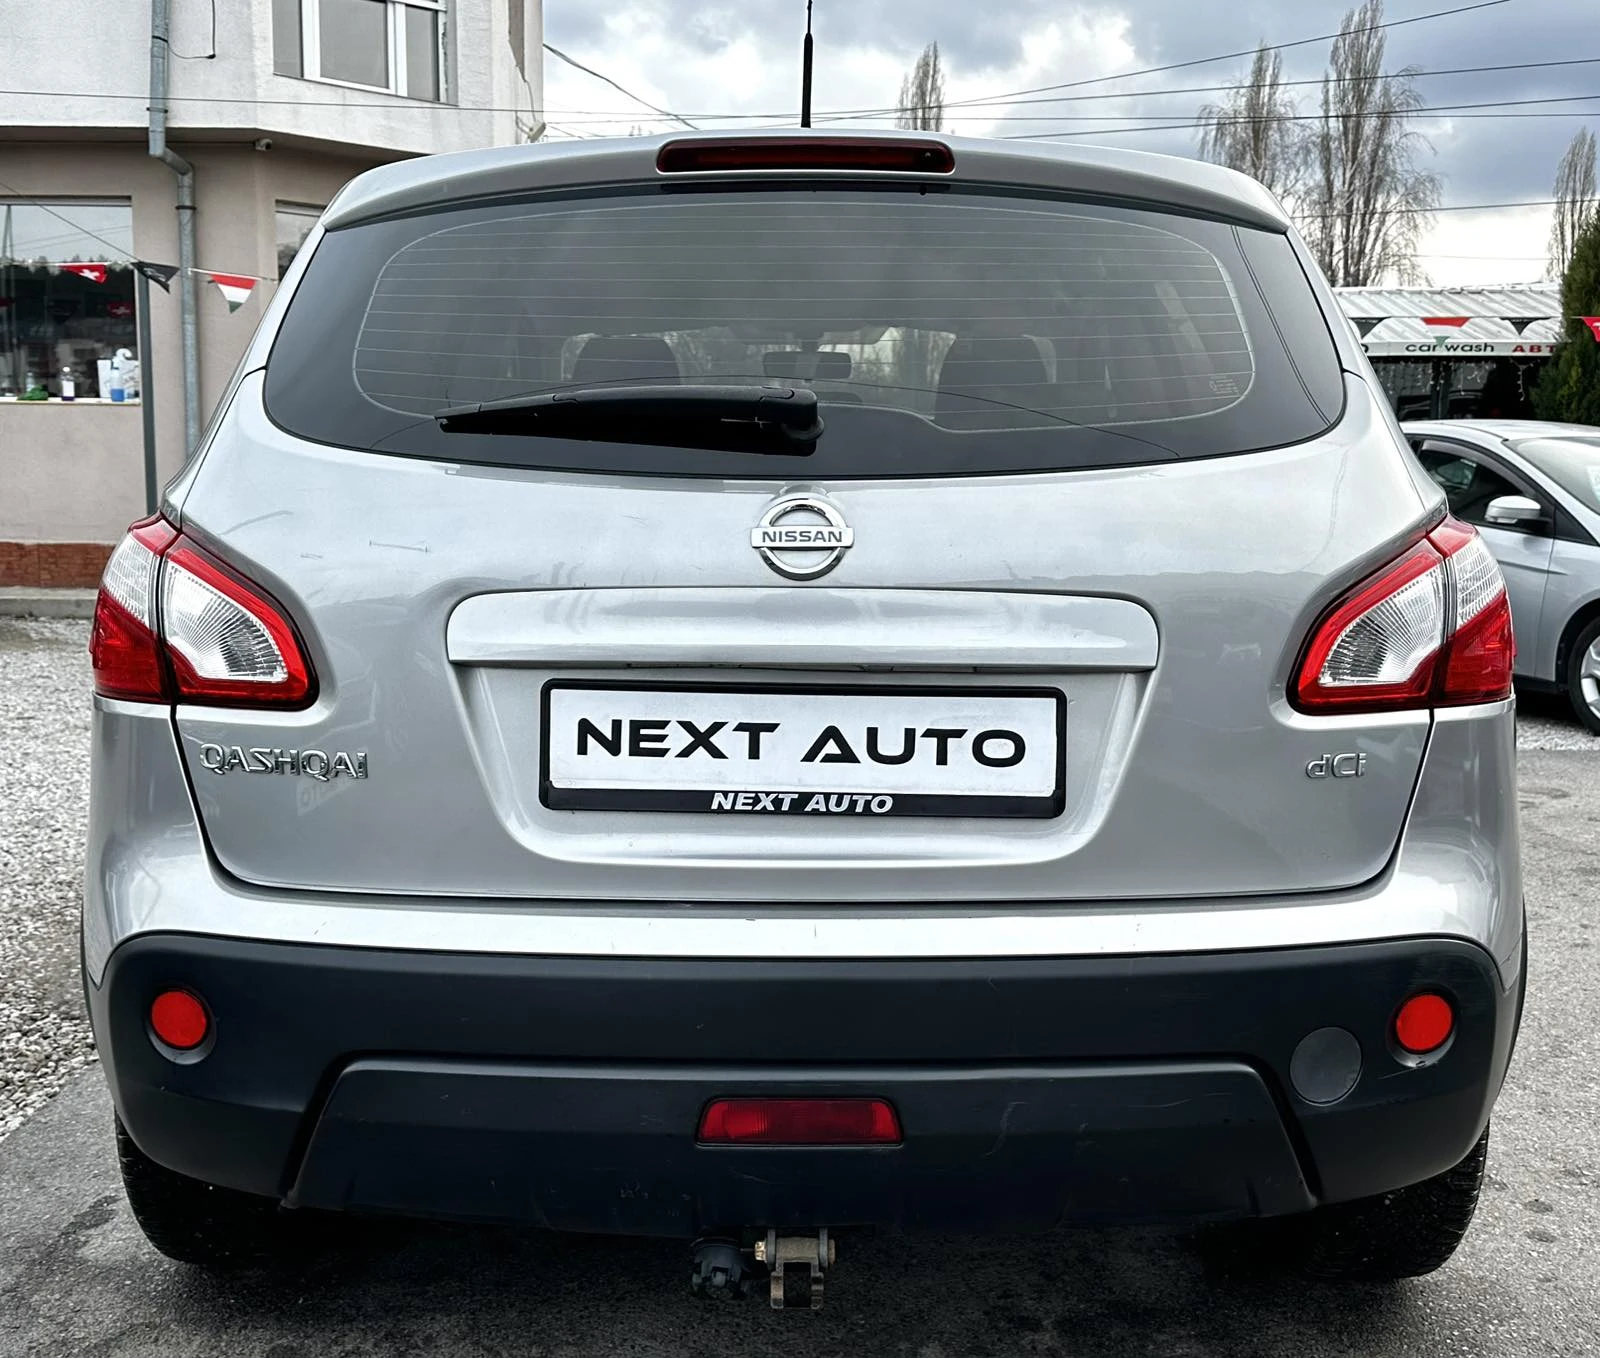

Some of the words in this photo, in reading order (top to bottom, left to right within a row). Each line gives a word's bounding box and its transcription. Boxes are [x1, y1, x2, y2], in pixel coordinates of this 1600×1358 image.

[1405, 344, 1437, 353] car
[1444, 342, 1495, 353] wash
[762, 530, 842, 543] NISSAN
[577, 717, 781, 760] NEXT
[800, 724, 1026, 768] AUTO
[199, 743, 369, 782] QASHQAI
[1306, 752, 1367, 779] dCi
[710, 791, 803, 813] NEXT
[803, 793, 894, 814] AUTO
